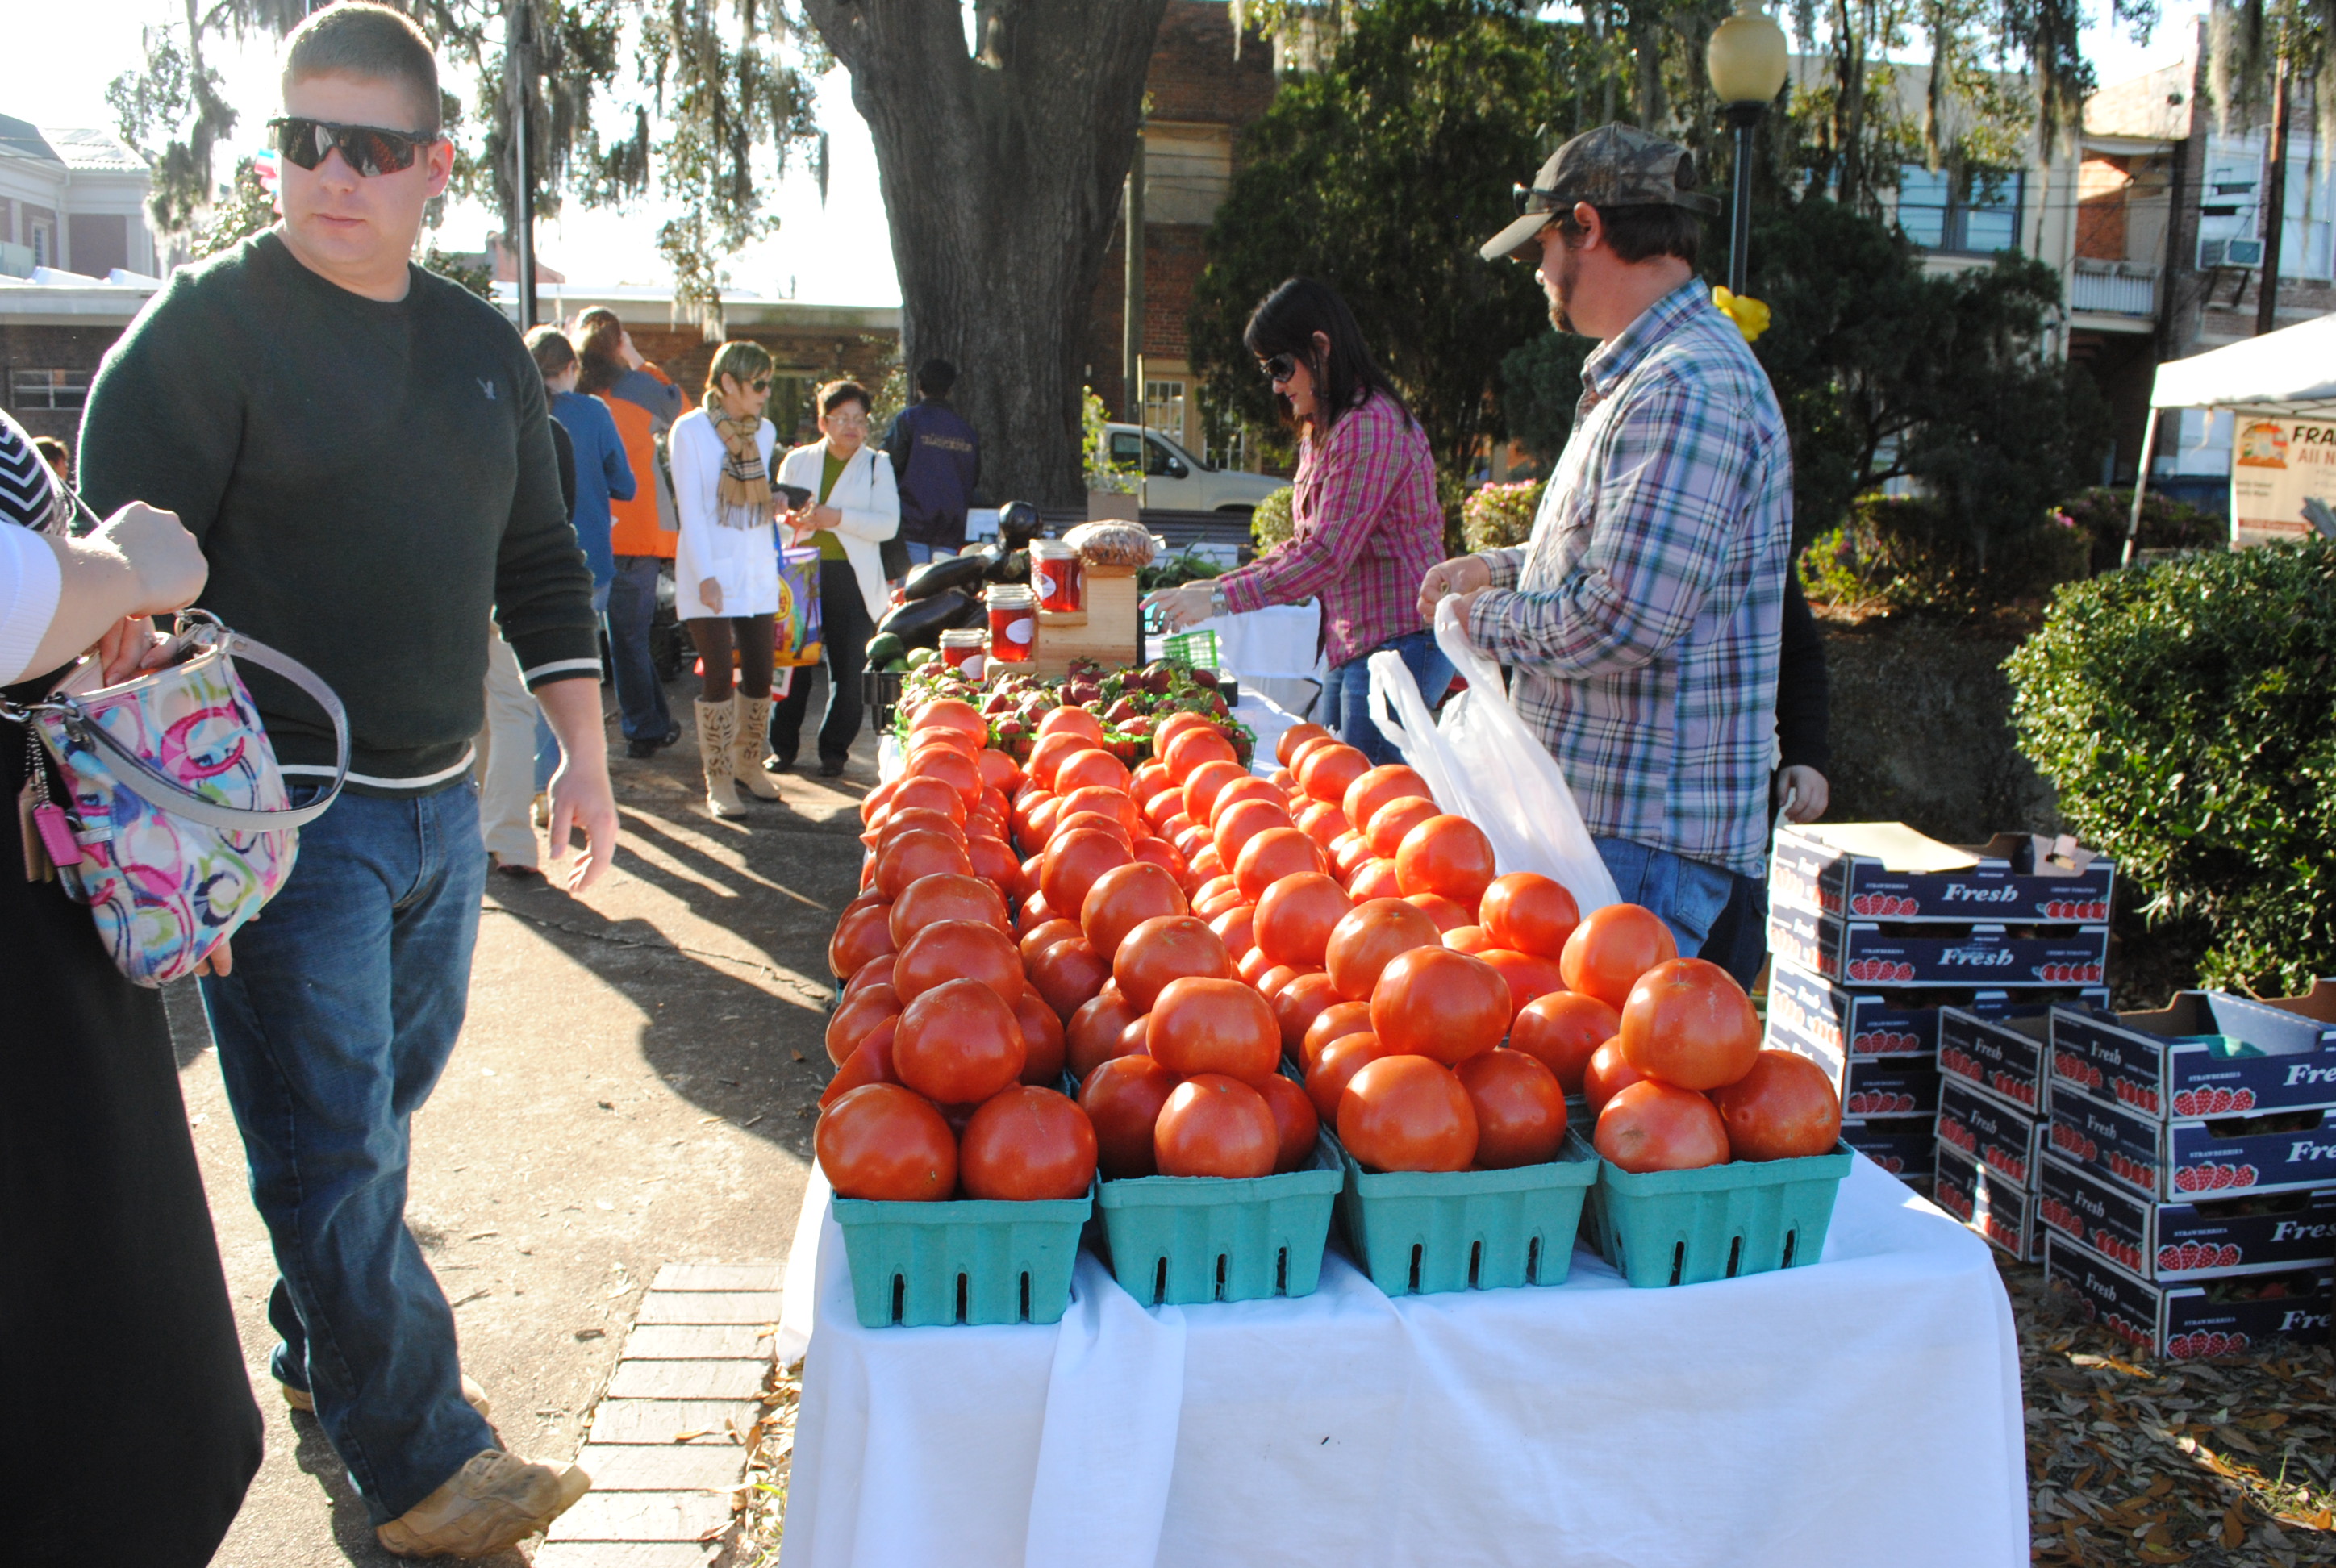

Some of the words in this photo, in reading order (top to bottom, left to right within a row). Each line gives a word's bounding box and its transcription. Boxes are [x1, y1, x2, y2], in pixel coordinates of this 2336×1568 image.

[2292, 425, 2336, 445] FRA
[1941, 883, 2019, 902] Fresh
[1937, 948, 2014, 966] Fresh
[1975, 1037, 2003, 1061] Fresh
[2091, 1040, 2121, 1065] Fresh
[2188, 1071, 2242, 1082] STRAWBERRIES
[1970, 1110, 1997, 1135] Fresh
[2087, 1114, 2117, 1140] Fresh
[2189, 1148, 2243, 1159] STRAWBERRIES
[2075, 1190, 2104, 1218] Fresh
[2174, 1228, 2228, 1237] STRAWBERRIES
[2085, 1272, 2117, 1303] Fresh
